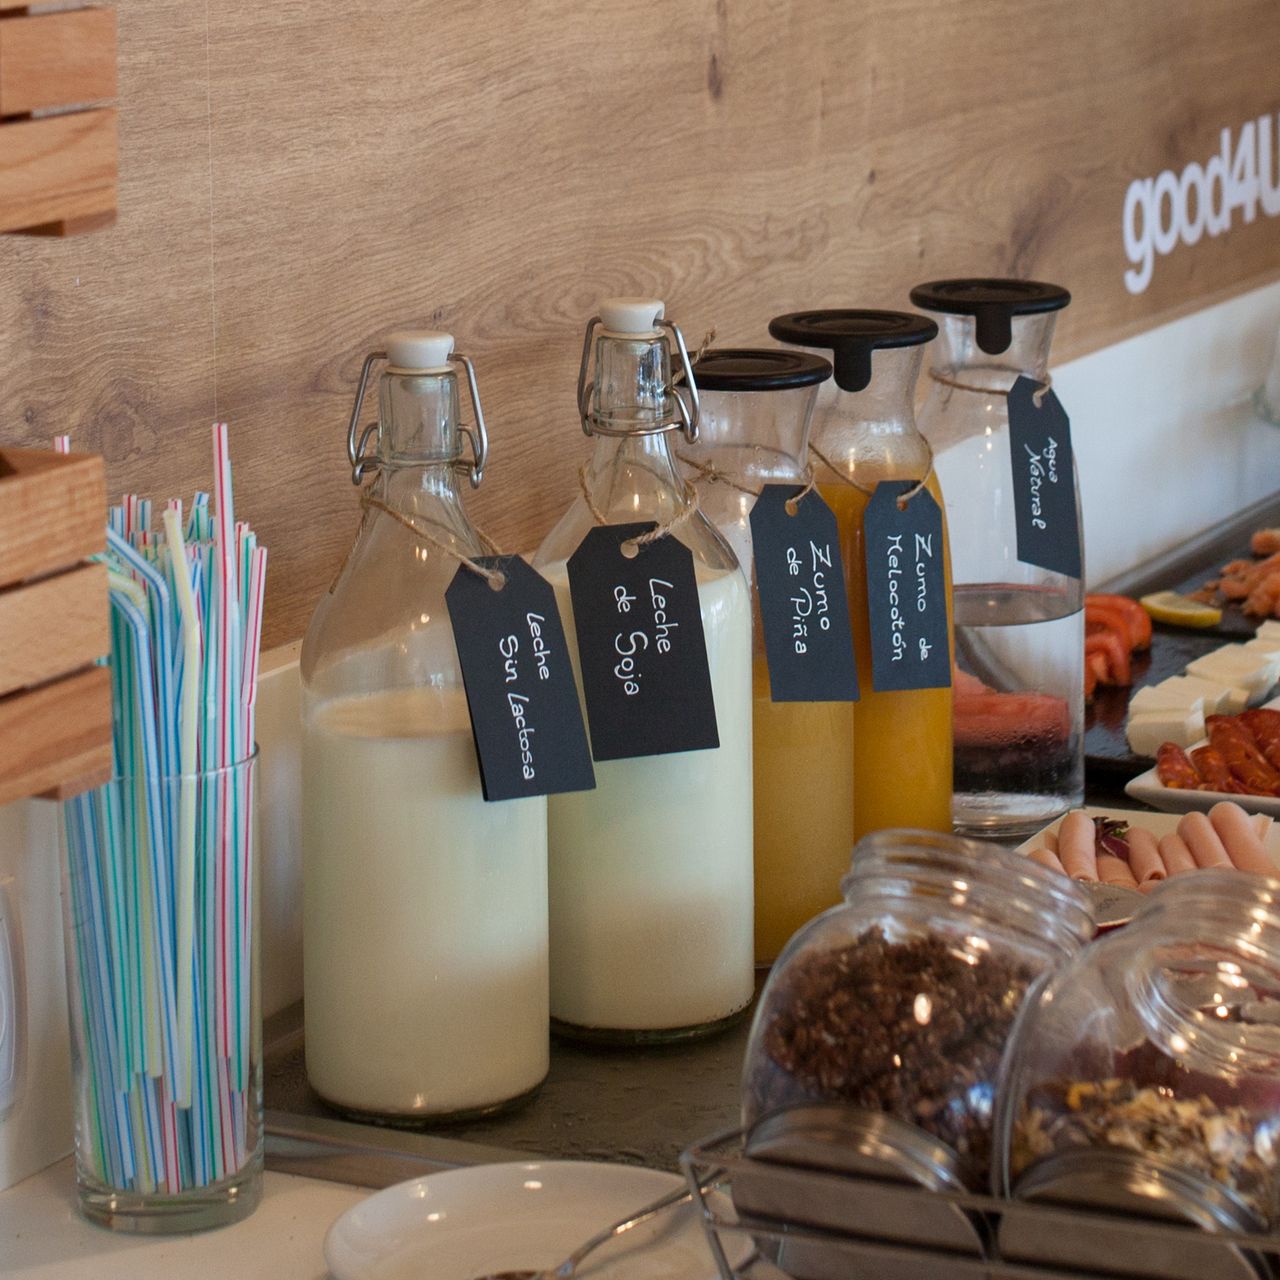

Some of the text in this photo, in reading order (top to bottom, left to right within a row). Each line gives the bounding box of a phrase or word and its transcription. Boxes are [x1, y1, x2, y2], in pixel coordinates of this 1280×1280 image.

[1023, 443, 1047, 530] Natural
[1042, 436, 1058, 483] Agua
[649, 578, 678, 653] Leche
[786, 547, 813, 654] de Piña
[809, 540, 832, 631] Zumo
[887, 534, 907, 662] Melocotón
[915, 533, 933, 661] Zumo de
[526, 612, 551, 680] Leche
[614, 585, 649, 696] de Soja
[499, 634, 536, 780] Sin Lactosa
